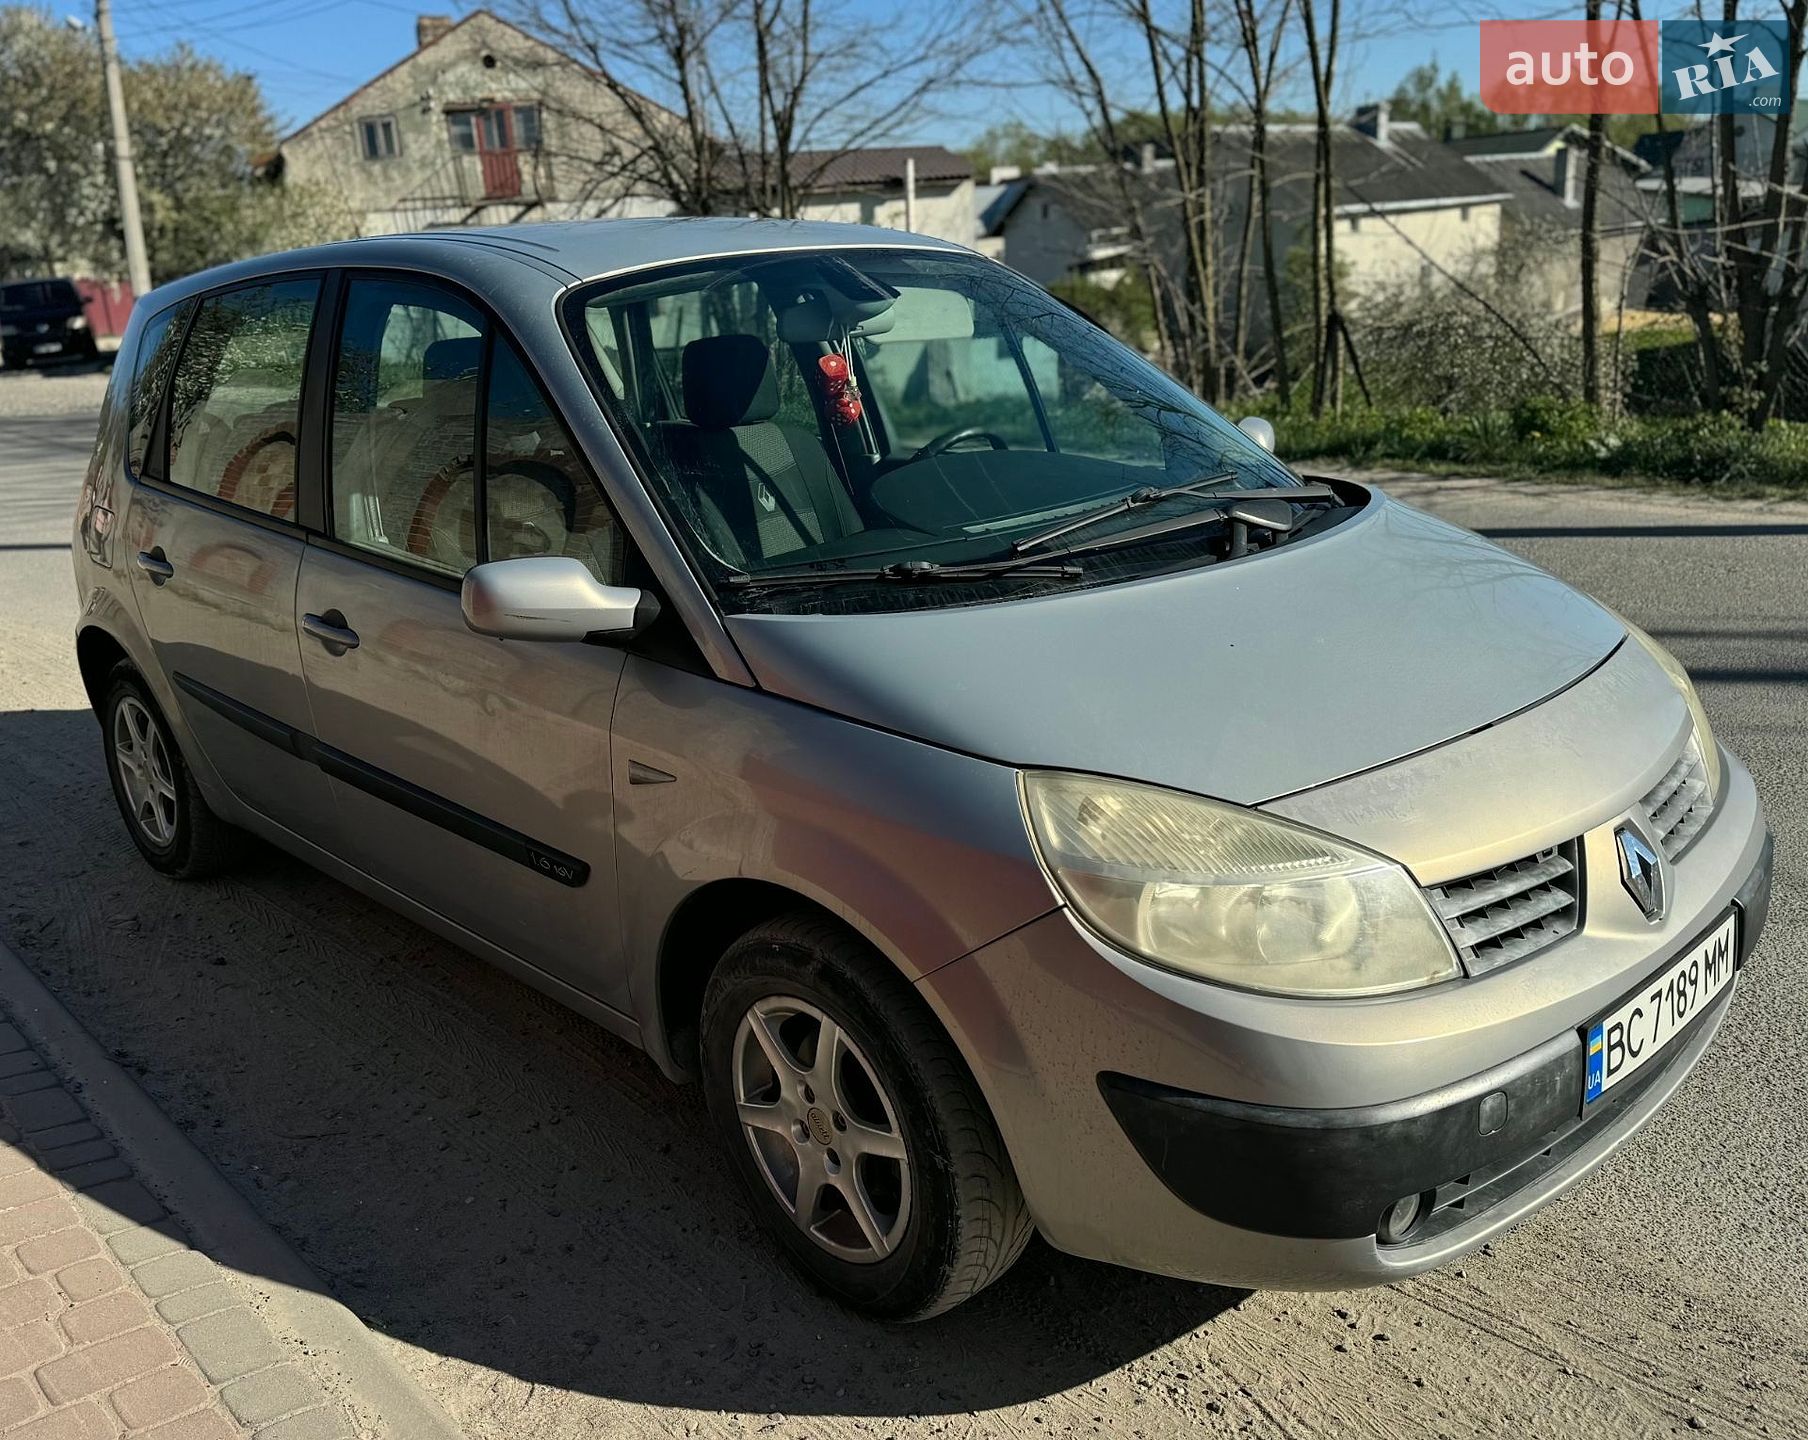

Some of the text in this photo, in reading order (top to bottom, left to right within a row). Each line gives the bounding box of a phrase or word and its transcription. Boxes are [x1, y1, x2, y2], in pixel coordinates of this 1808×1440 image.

[1606, 927, 1730, 1079] BC 7189 MM
[1587, 1071, 1601, 1090] UA
